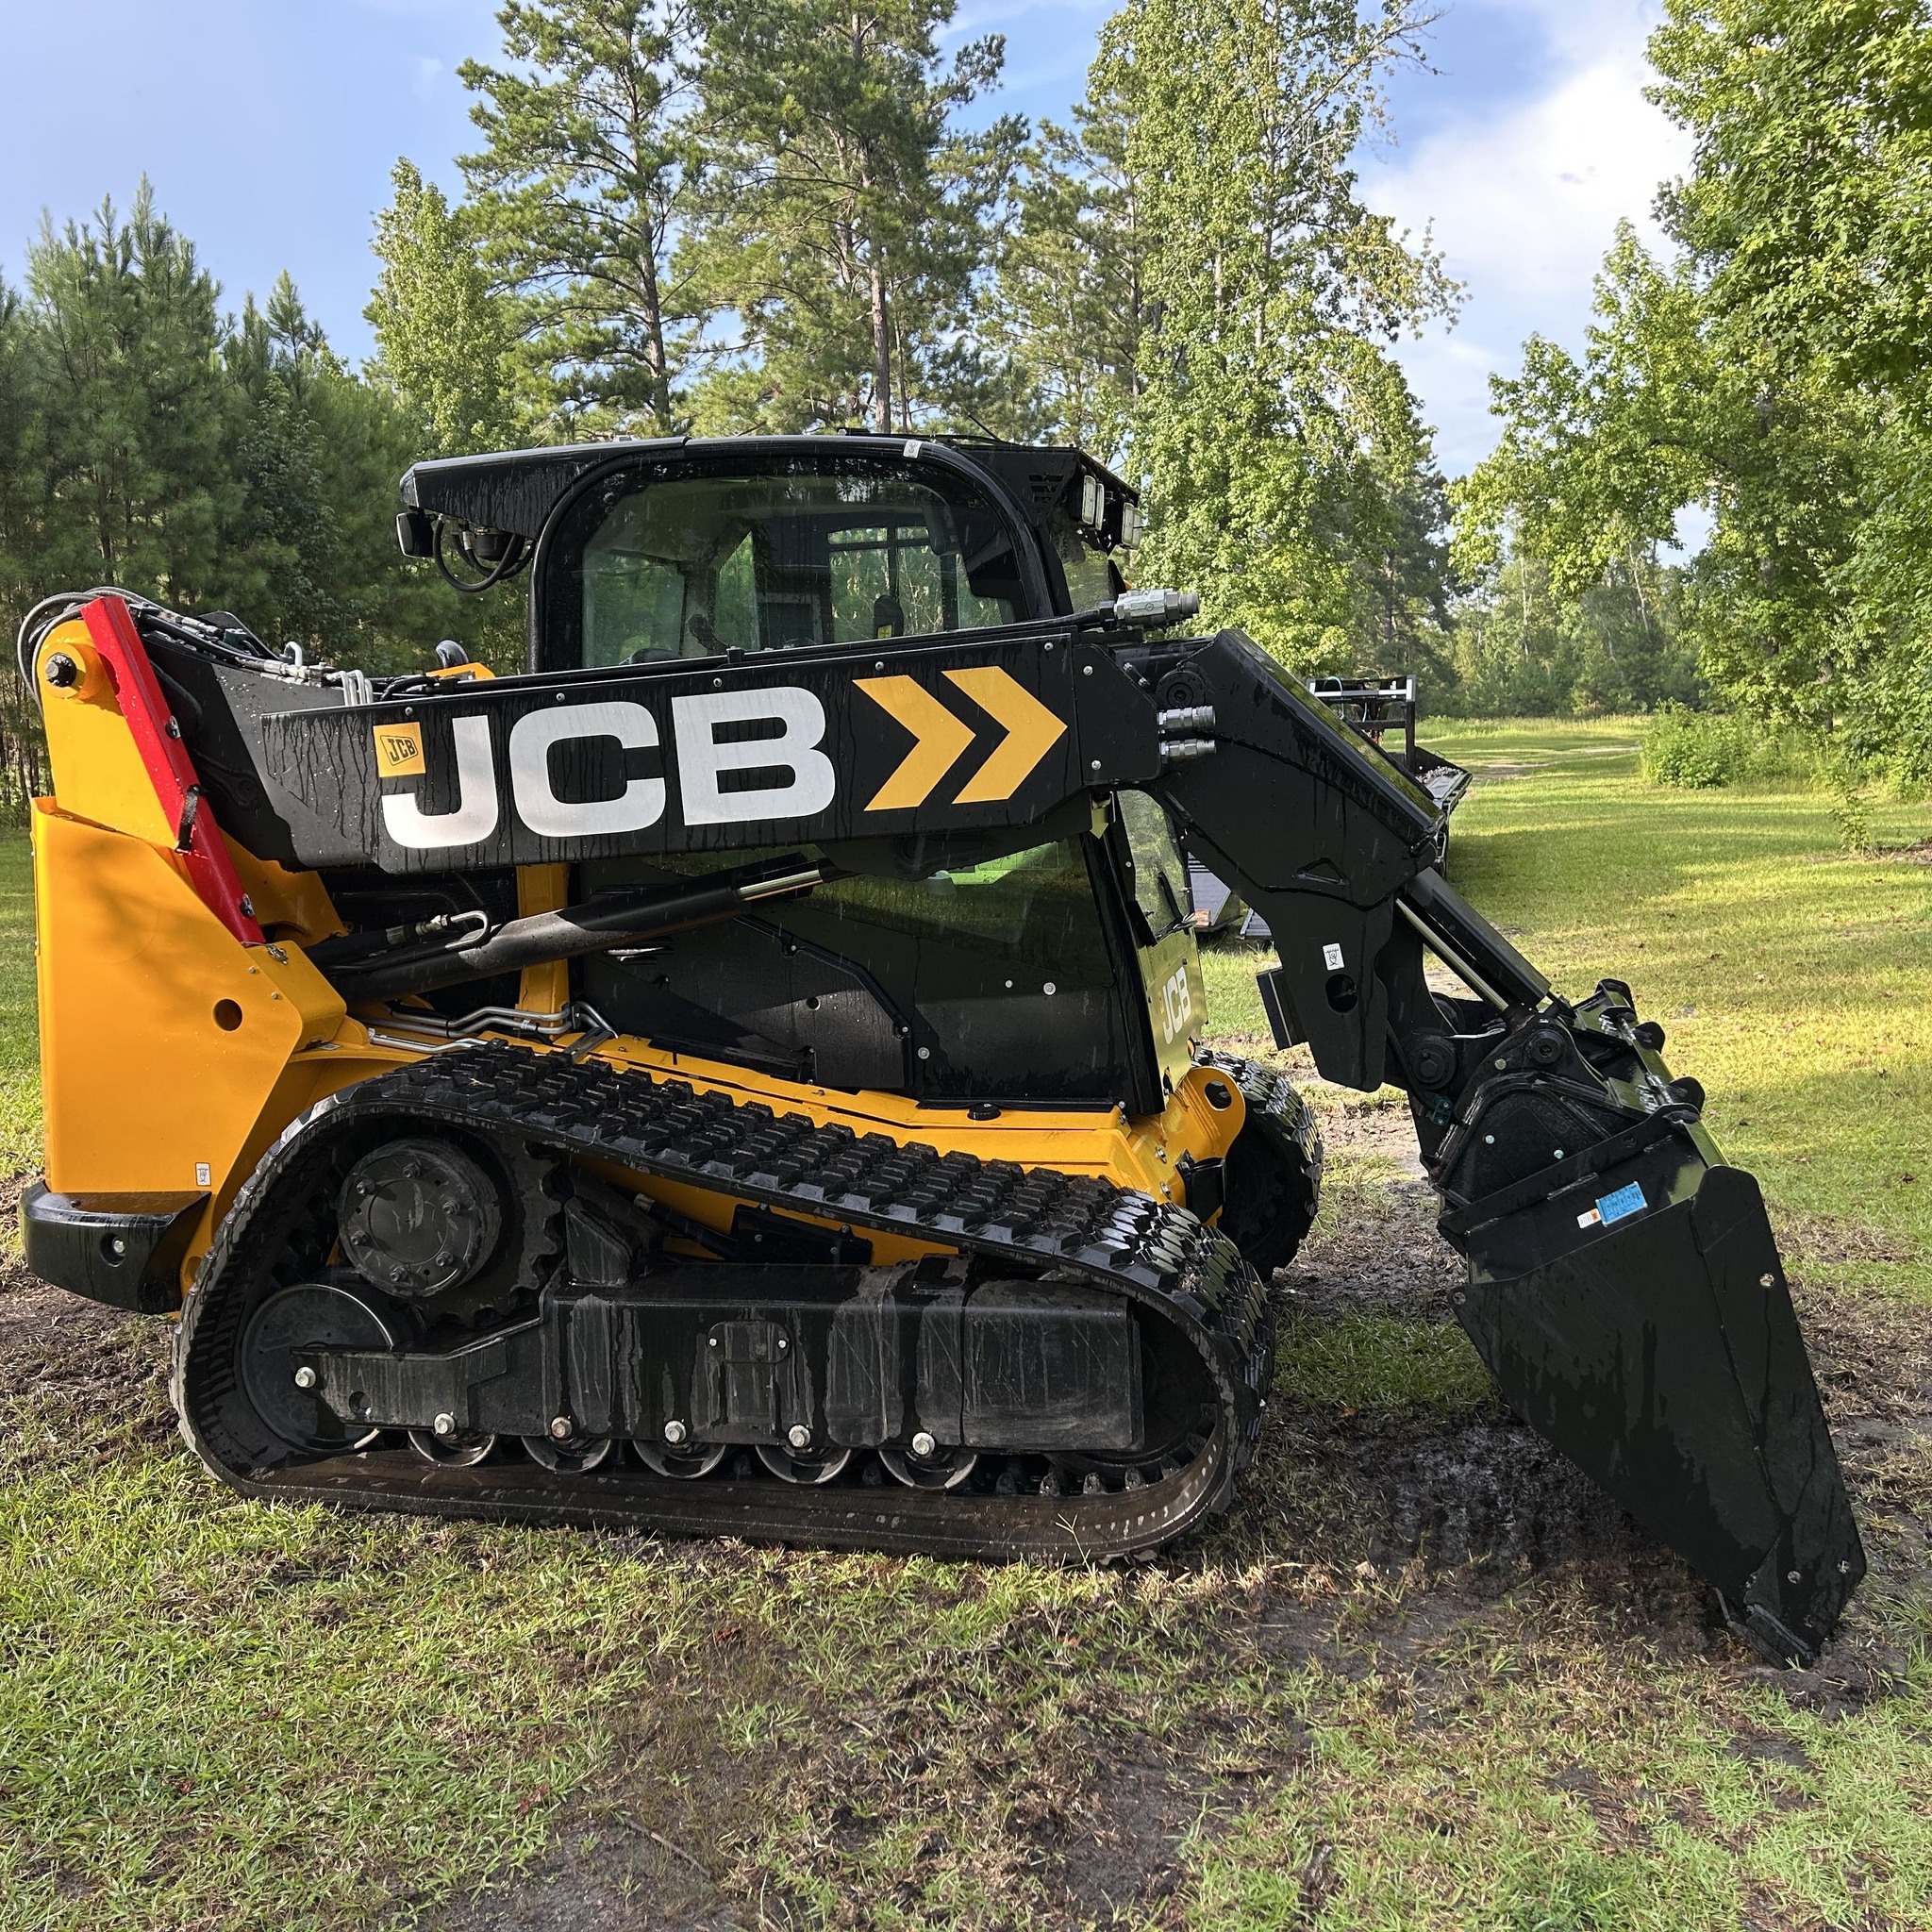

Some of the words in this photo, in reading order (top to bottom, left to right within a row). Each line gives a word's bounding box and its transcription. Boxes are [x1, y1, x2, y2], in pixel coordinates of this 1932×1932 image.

[381, 687, 835, 848] JCB
[388, 739, 416, 762] JCB
[1162, 966, 1191, 1044] JCB
